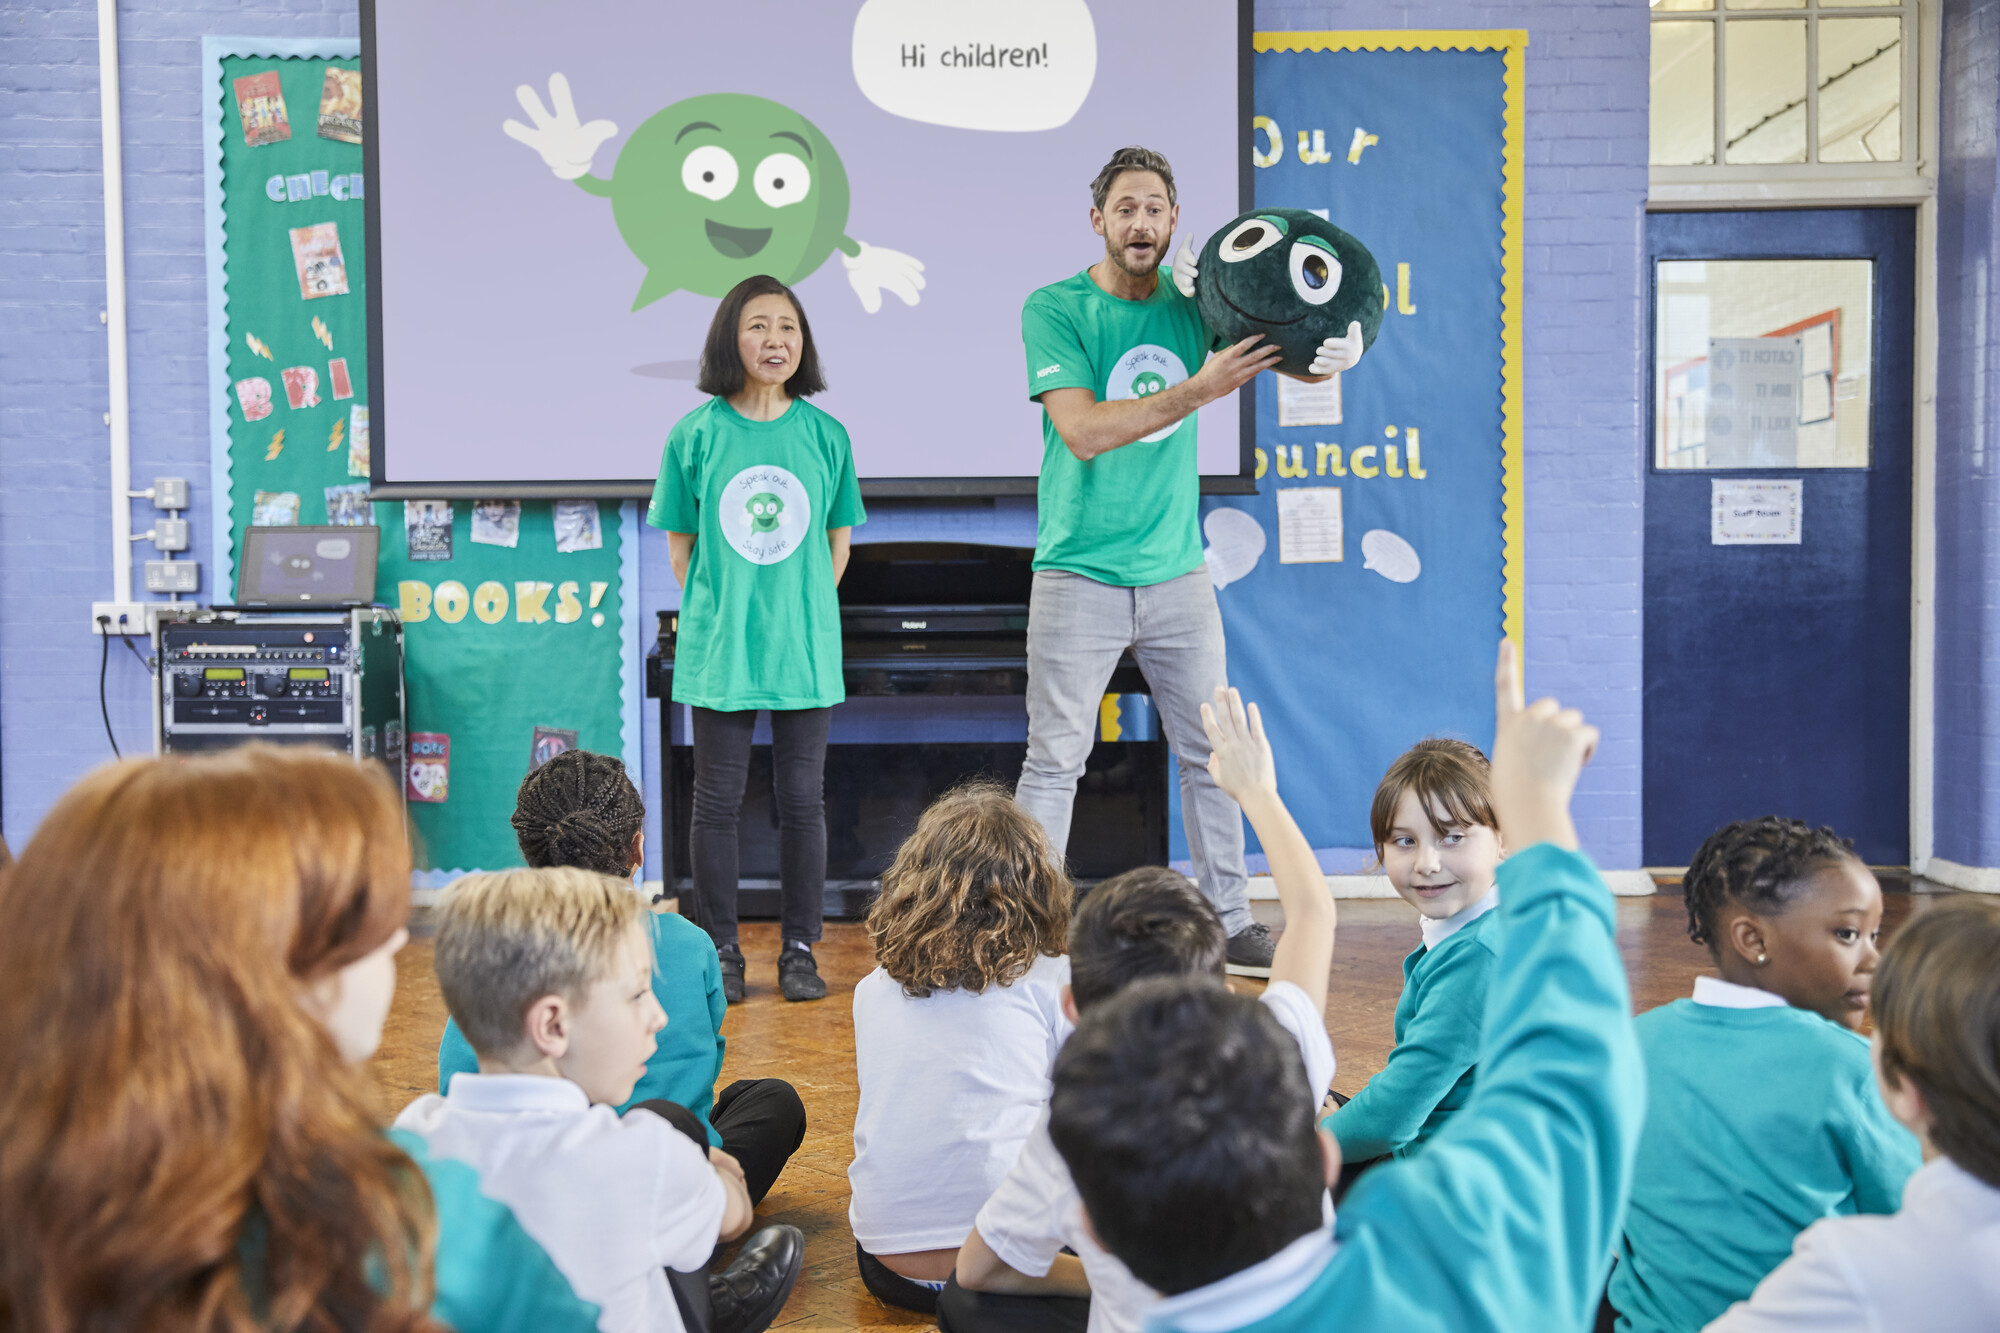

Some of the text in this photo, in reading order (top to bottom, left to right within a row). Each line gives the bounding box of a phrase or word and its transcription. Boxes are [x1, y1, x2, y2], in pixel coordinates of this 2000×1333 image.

[901, 43, 1048, 68] Hi children!
[1253, 115, 1379, 168] Our
[1125, 350, 1168, 370] Speak out
[1036, 364, 1061, 379] NSPCC
[739, 472, 789, 489] Speak out
[743, 540, 789, 560] Stay safe
[398, 580, 609, 628] BOOKS!
